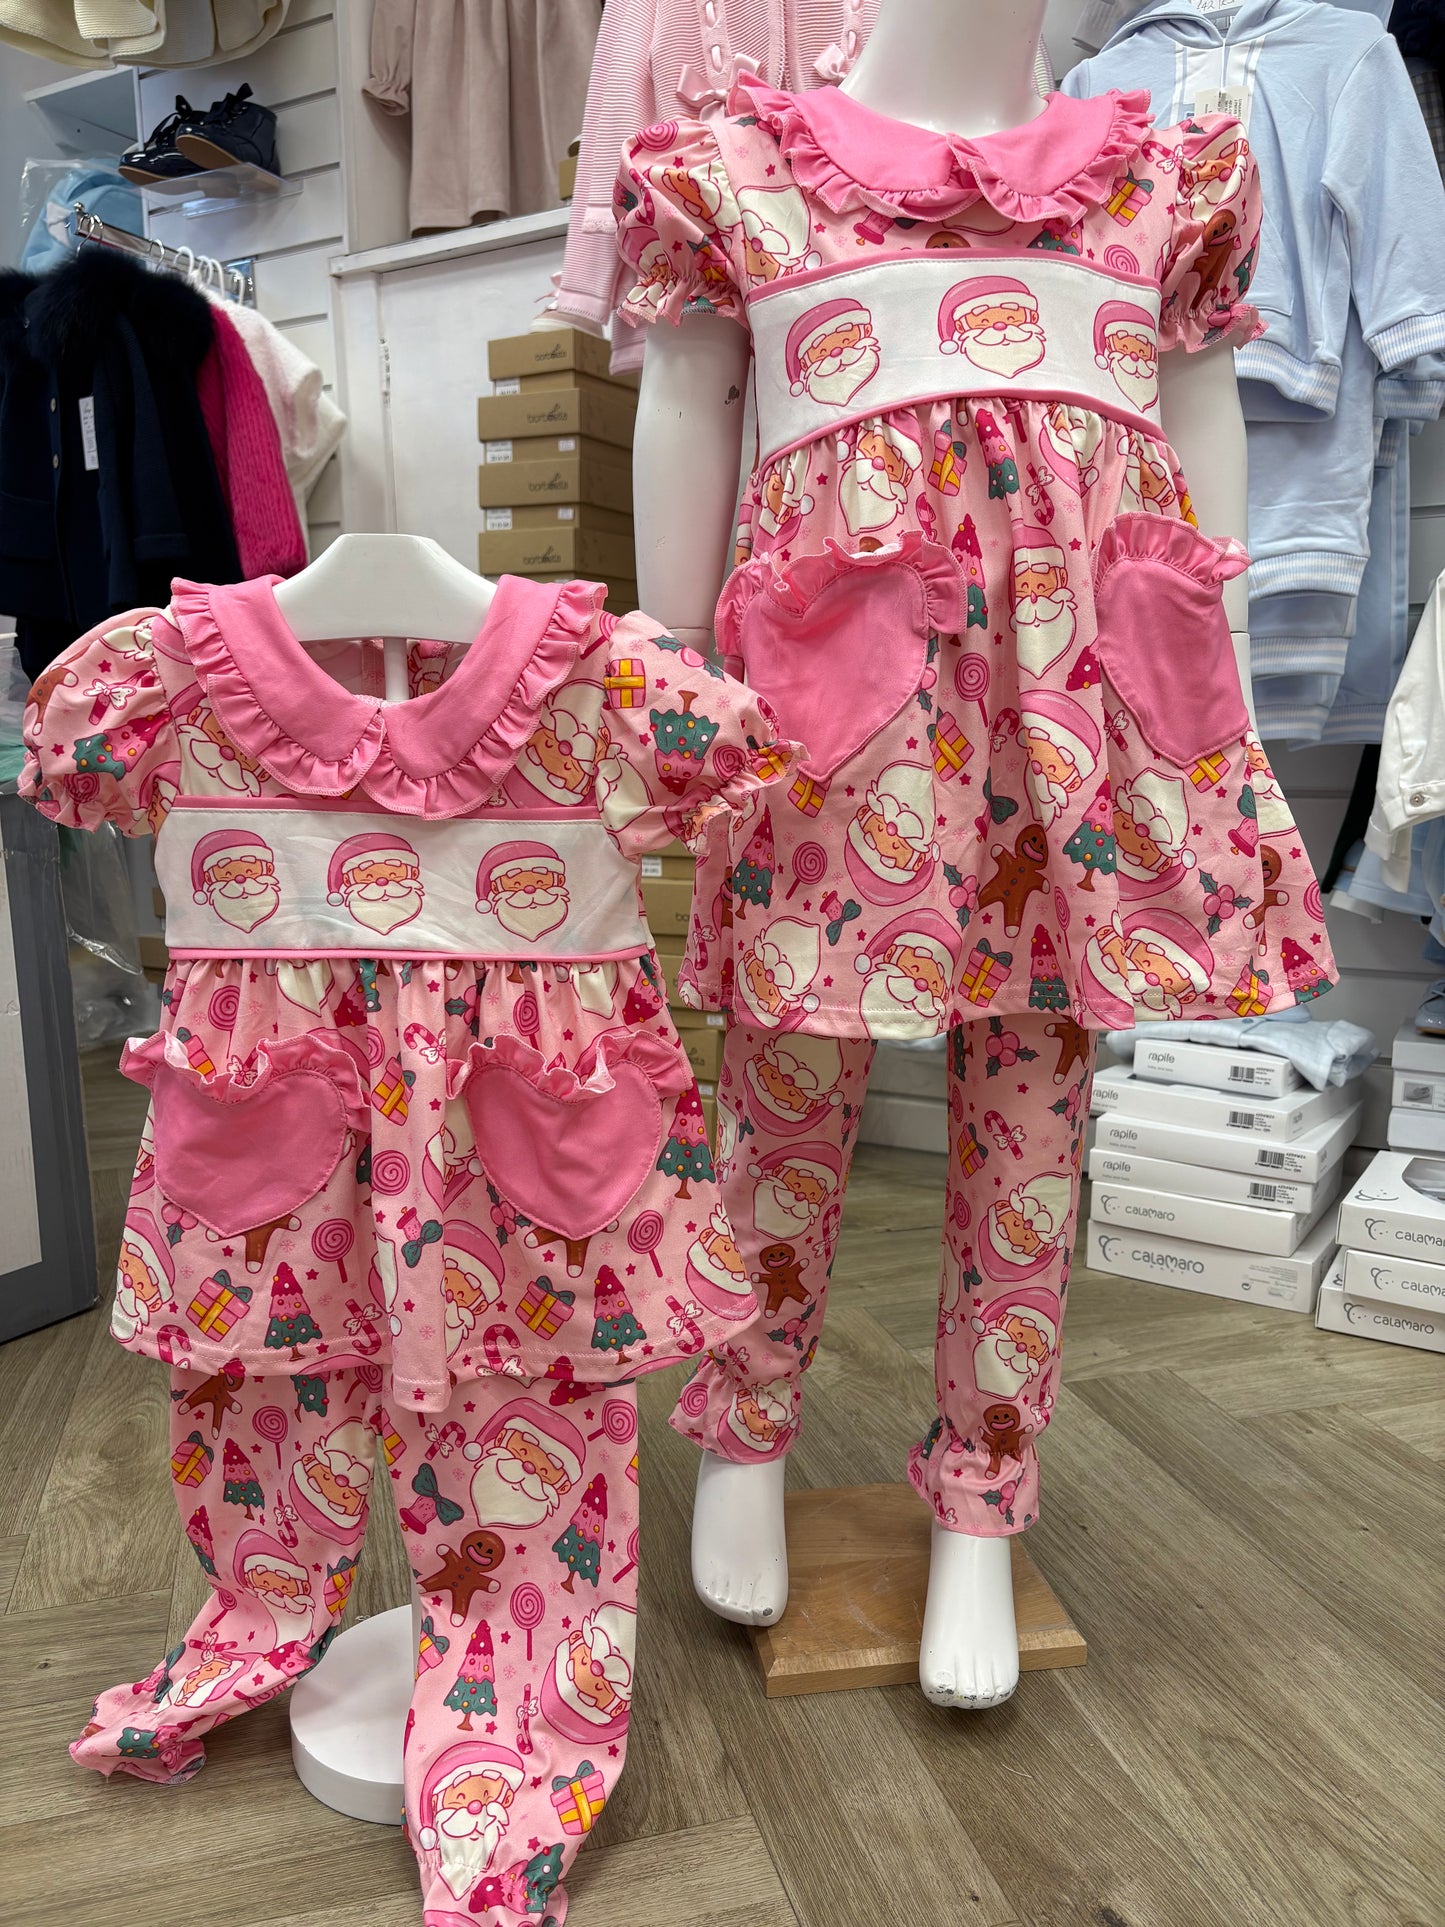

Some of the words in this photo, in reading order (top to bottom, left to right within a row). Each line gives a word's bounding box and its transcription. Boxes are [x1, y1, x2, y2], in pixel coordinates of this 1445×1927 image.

[1148, 1052, 1175, 1064] rapife
[1092, 1089, 1119, 1101] rapife
[1109, 1128, 1138, 1141] rapife
[1102, 1160, 1131, 1173] rapife
[1125, 1205, 1175, 1221] calamaro
[1131, 1249, 1204, 1274] calamaro
[1372, 1314, 1435, 1335] calamaro
